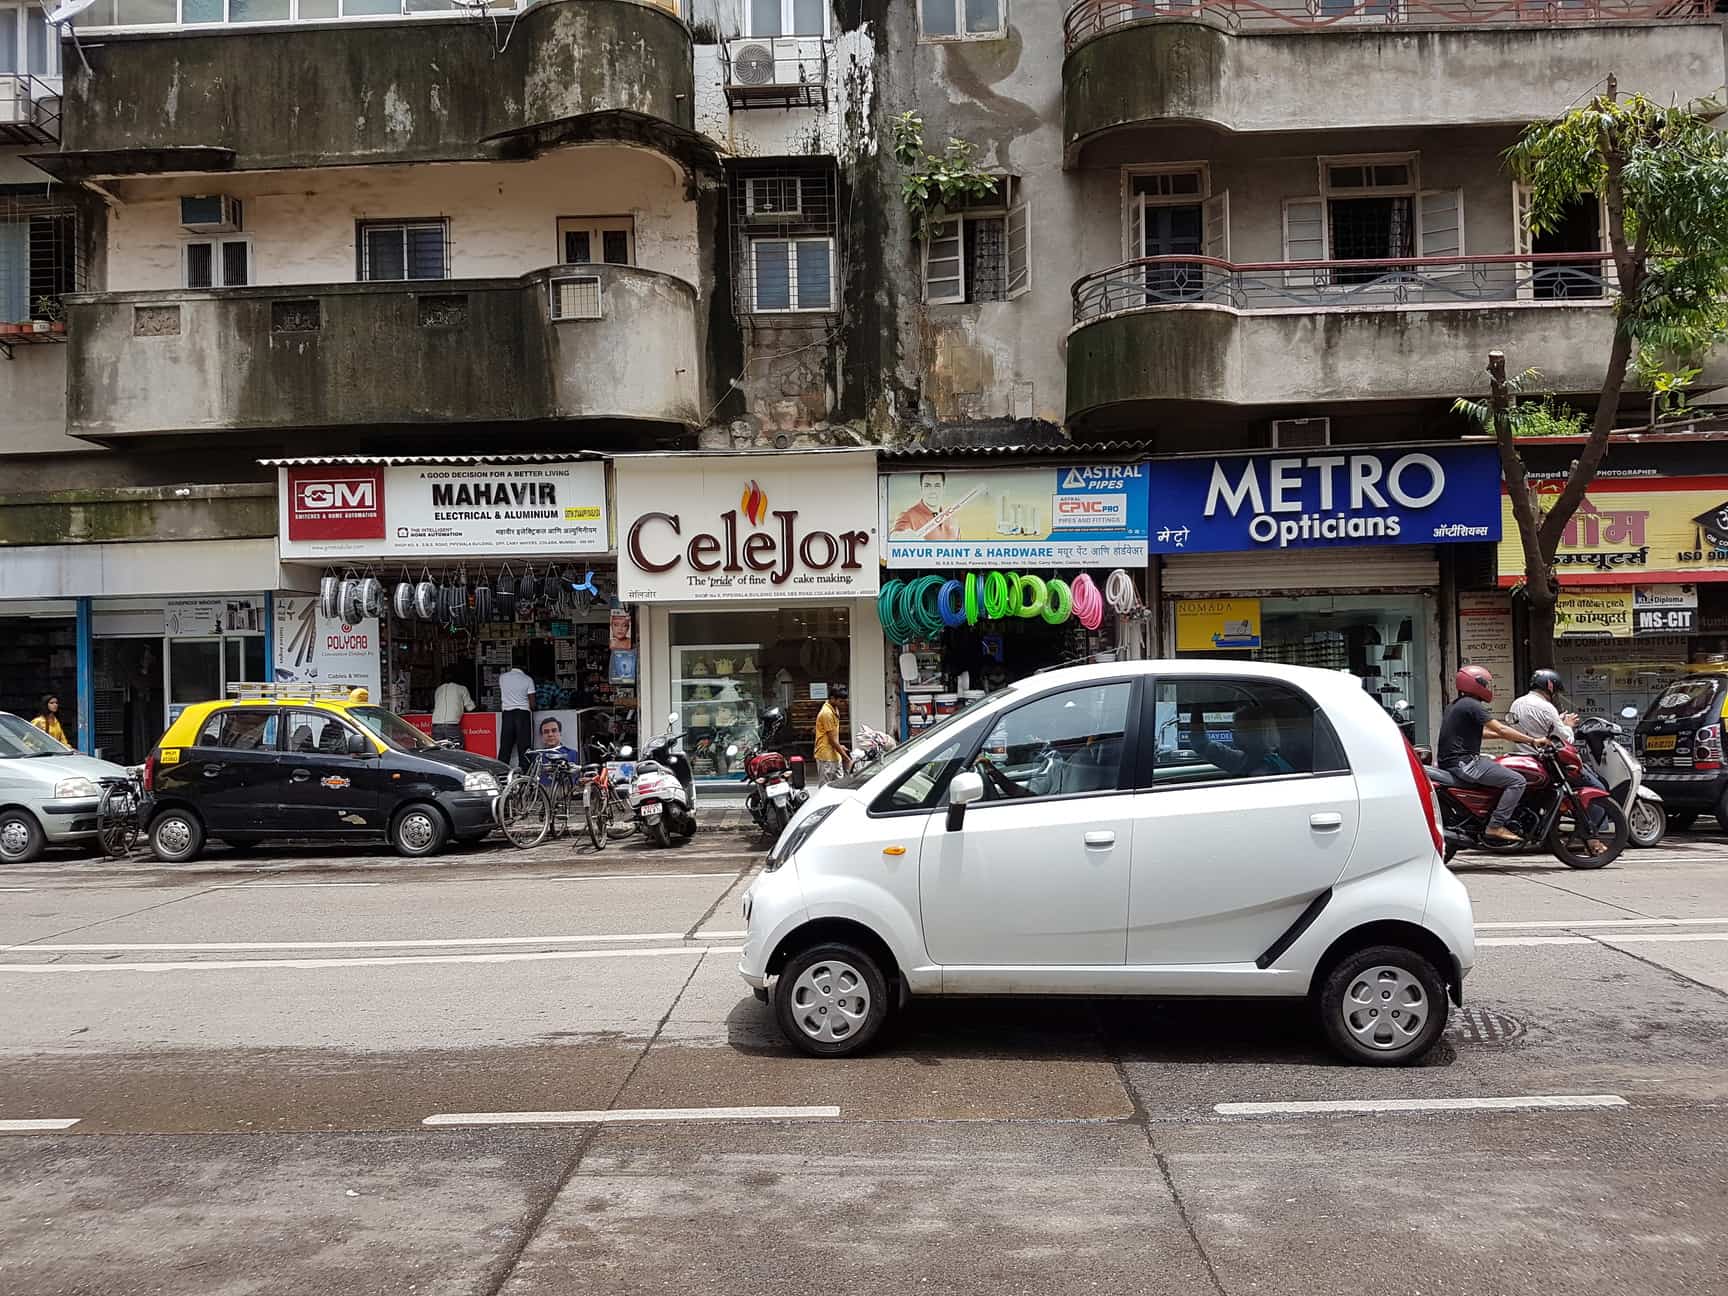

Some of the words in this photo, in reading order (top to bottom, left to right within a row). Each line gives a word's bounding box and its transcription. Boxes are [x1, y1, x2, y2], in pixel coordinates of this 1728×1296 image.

[1083, 466, 1142, 479] ASTRAL
[1088, 480, 1125, 490] PIPES
[1203, 452, 1446, 518] METRO
[432, 482, 557, 507] MAHAVIR
[434, 511, 492, 520] ELECTRICAL
[494, 511, 502, 520] &
[504, 510, 558, 519] ALUMINIUM
[1248, 511, 1402, 548] Opticians
[1156, 525, 1191, 548] मेट्रो
[626, 509, 870, 585] CeleJor
[891, 548, 933, 558] MAYUR
[936, 548, 970, 558] PAINT
[974, 548, 983, 557] &
[986, 547, 1053, 557] HARDWARE
[1677, 551, 1702, 561] ISO
[1707, 551, 1728, 561] 90
[687, 576, 706, 586] The
[737, 575, 748, 585] of
[749, 575, 767, 584] fine
[793, 575, 815, 585] cake
[816, 573, 853, 585] making.
[1655, 596, 1683, 605] Diploma
[1179, 602, 1232, 613] NOMADA
[1640, 611, 1692, 628] MS-CIT
[327, 635, 368, 650] POLYCAB
